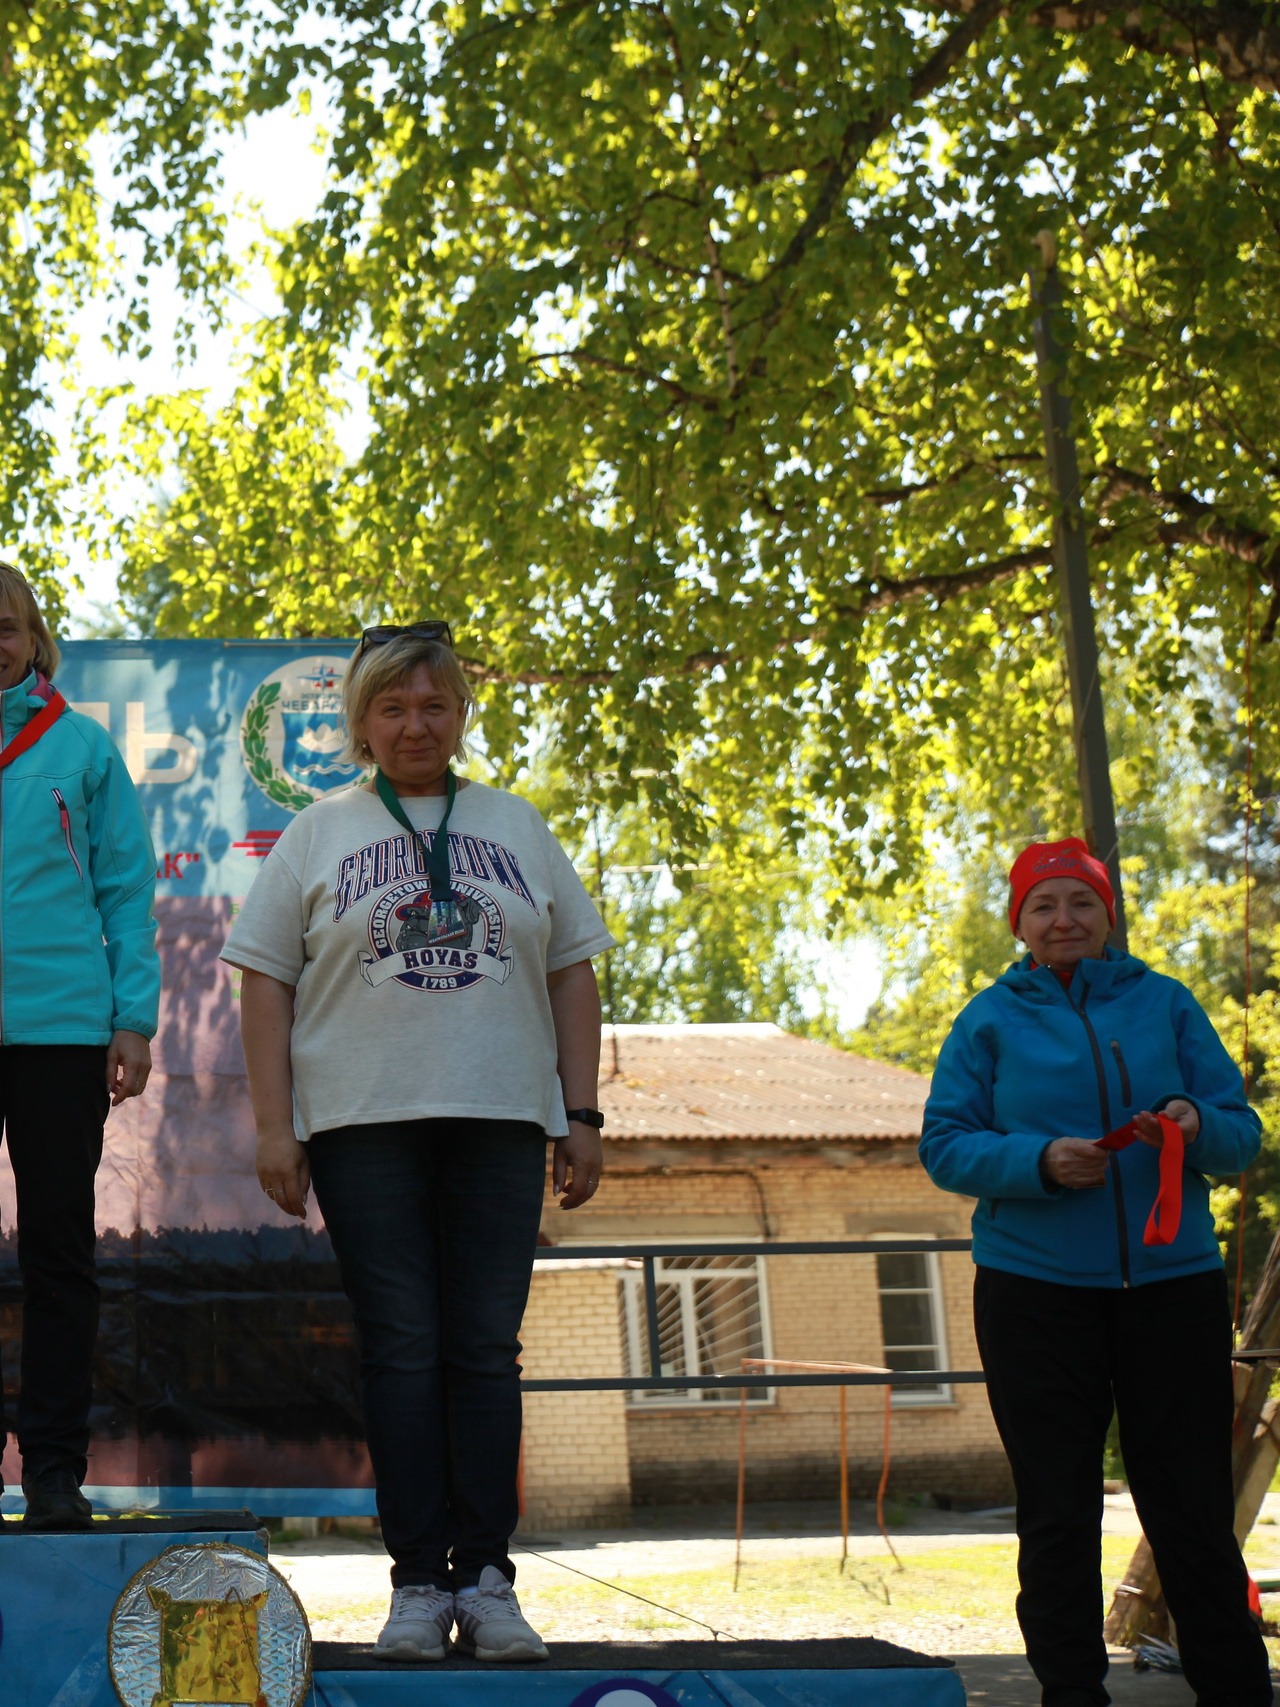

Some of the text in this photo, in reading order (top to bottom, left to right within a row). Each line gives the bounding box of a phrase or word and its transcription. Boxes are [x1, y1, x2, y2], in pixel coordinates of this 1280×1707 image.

[281, 700, 344, 712] ЧЕБАРК
[333, 829, 540, 923] GEORGTOWN
[372, 880, 501, 952] GEORGETOW UNIVERSITY
[402, 949, 478, 970] HOYAS
[421, 976, 458, 989] 1789
